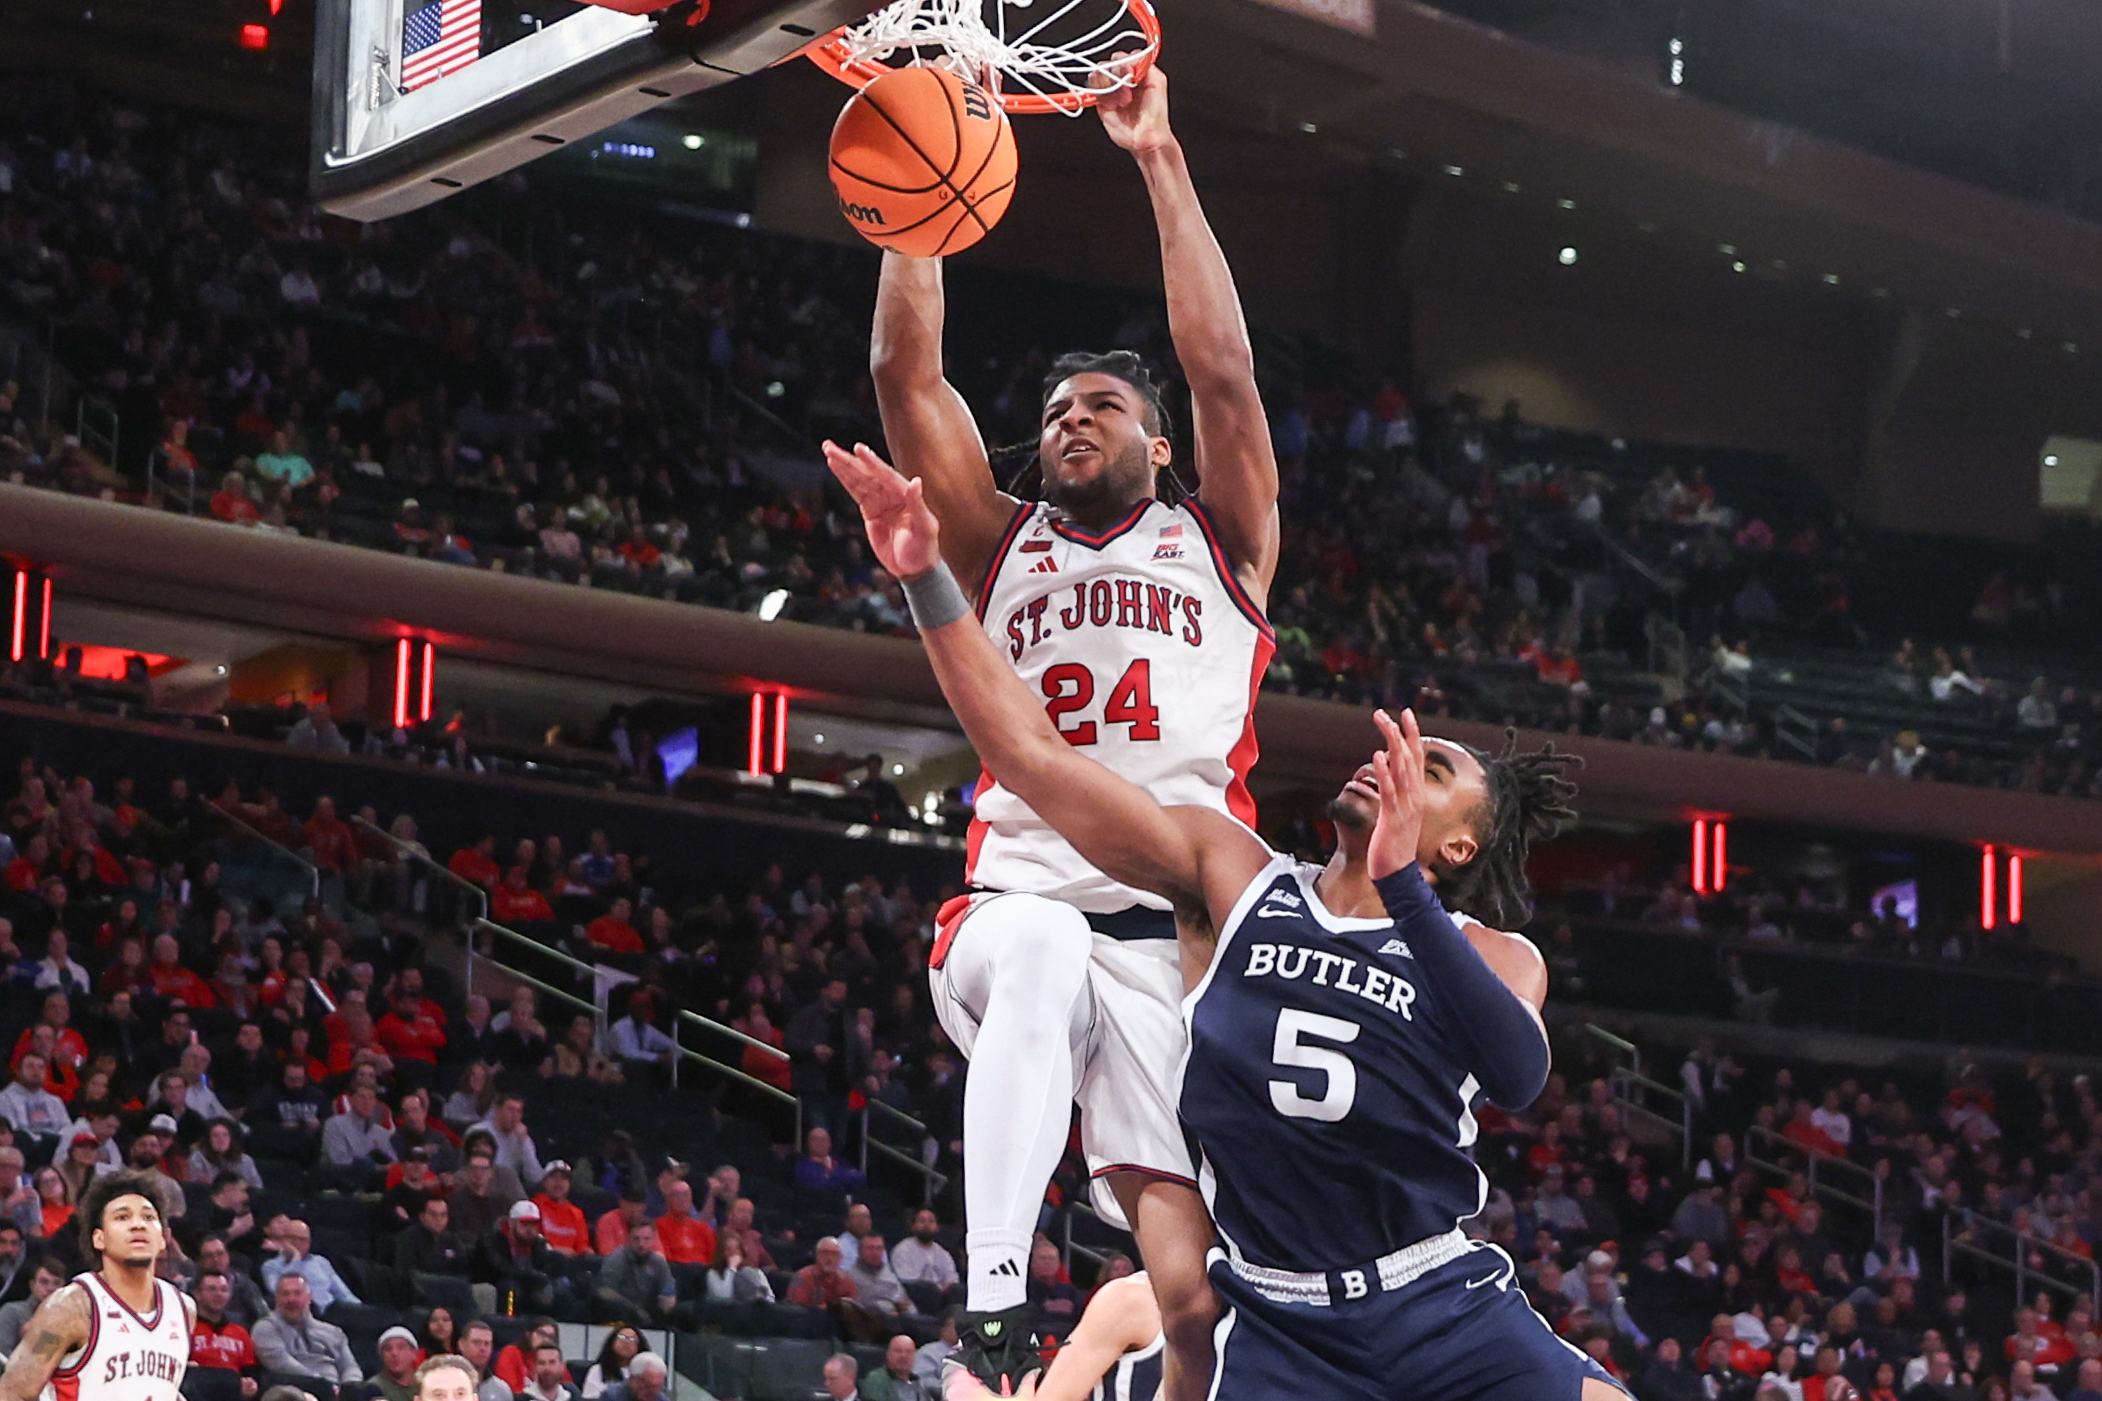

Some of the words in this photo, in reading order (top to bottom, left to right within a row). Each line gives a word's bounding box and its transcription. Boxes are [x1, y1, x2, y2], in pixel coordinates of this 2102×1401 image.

[1006, 594, 1052, 665] ST.
[1060, 579, 1203, 647] JOHN'S
[1041, 658, 1161, 747] 24
[1243, 943, 1417, 1022] BUTLER
[1268, 1007, 1361, 1122] 5
[1340, 1270, 1369, 1299] B
[103, 1351, 132, 1384] ST.
